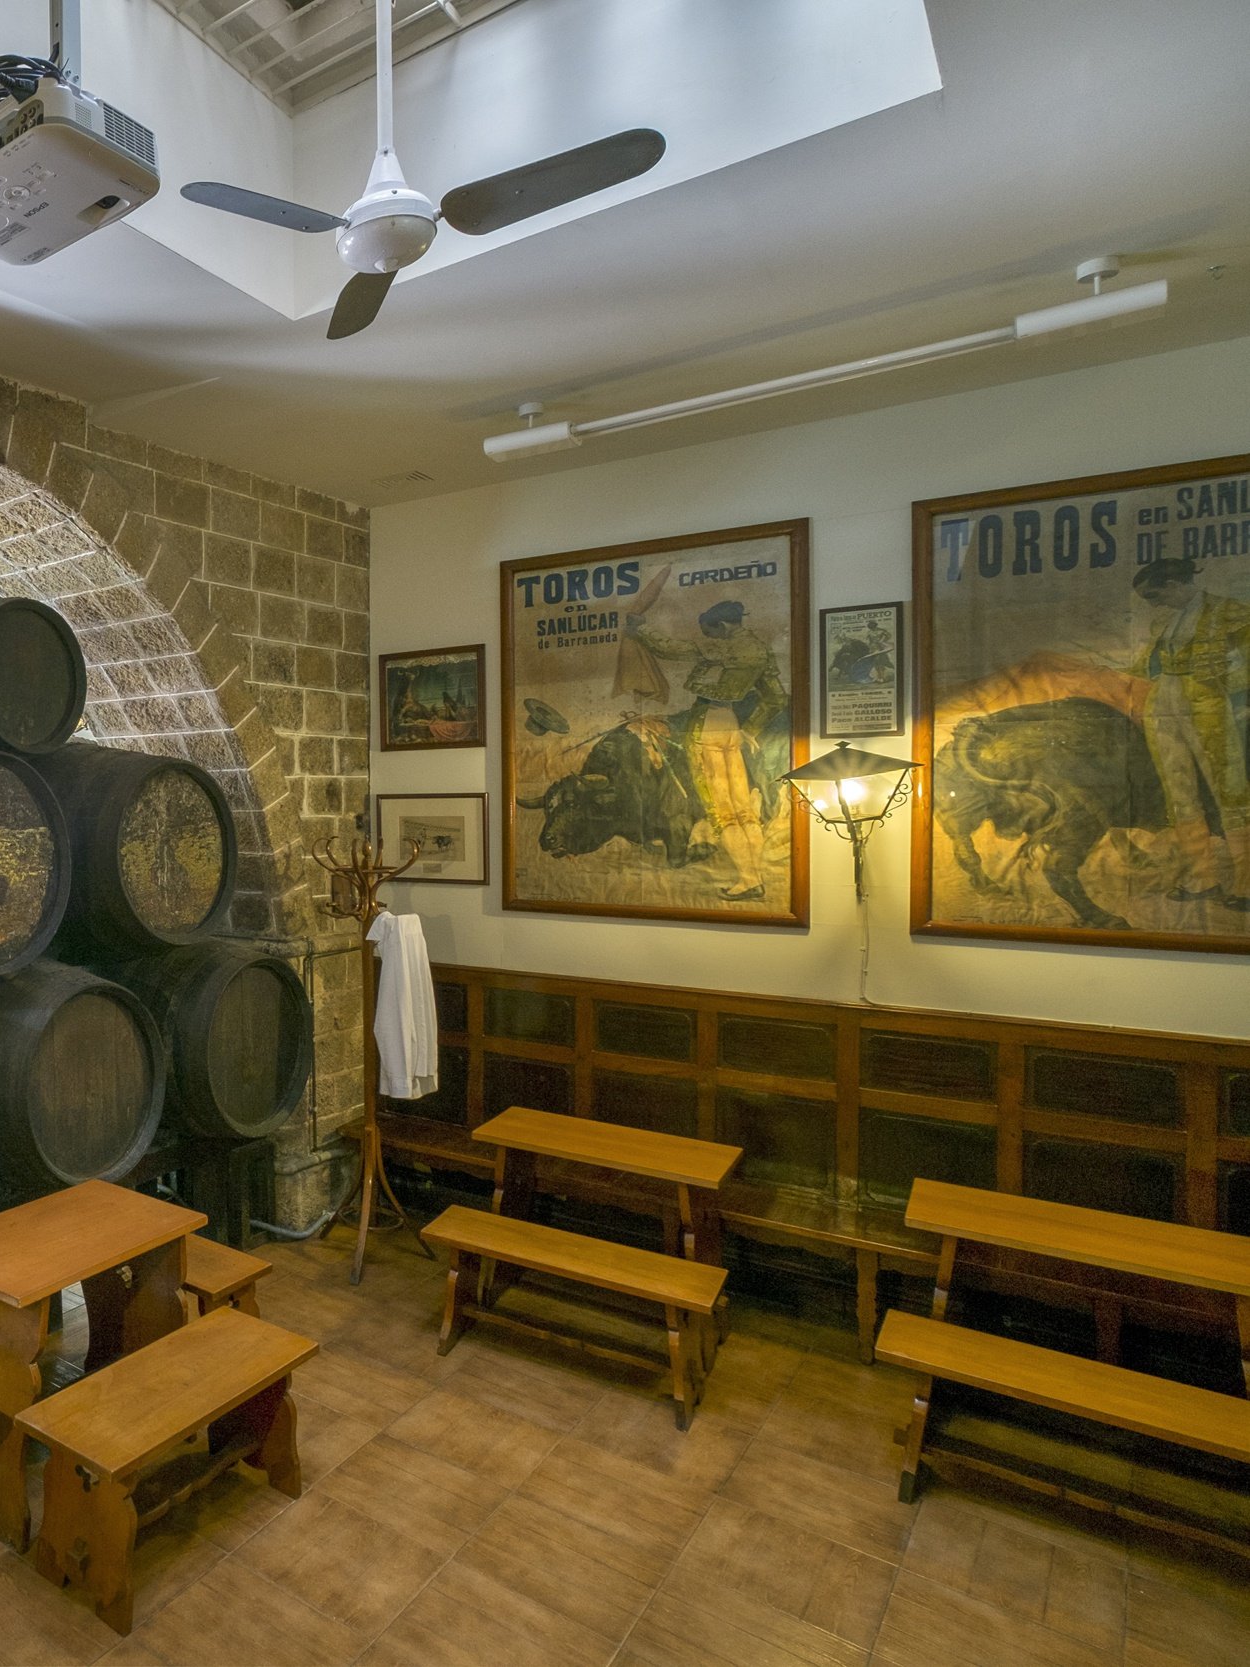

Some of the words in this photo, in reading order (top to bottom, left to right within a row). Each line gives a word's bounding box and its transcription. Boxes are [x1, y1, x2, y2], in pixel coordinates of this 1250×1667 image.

[940, 500, 1117, 582] TOROS
[1138, 506, 1168, 525] en
[1136, 530, 1169, 565] DE
[516, 561, 639, 608] TOROS
[678, 560, 777, 587] CARDEÑO
[564, 604, 587, 612] en
[857, 610, 892, 620] PUERTO
[537, 611, 618, 637] SANLÚCAR
[538, 639, 550, 650] de
[557, 632, 617, 648] Barrameda
[854, 708, 892, 716] GALLOSO
